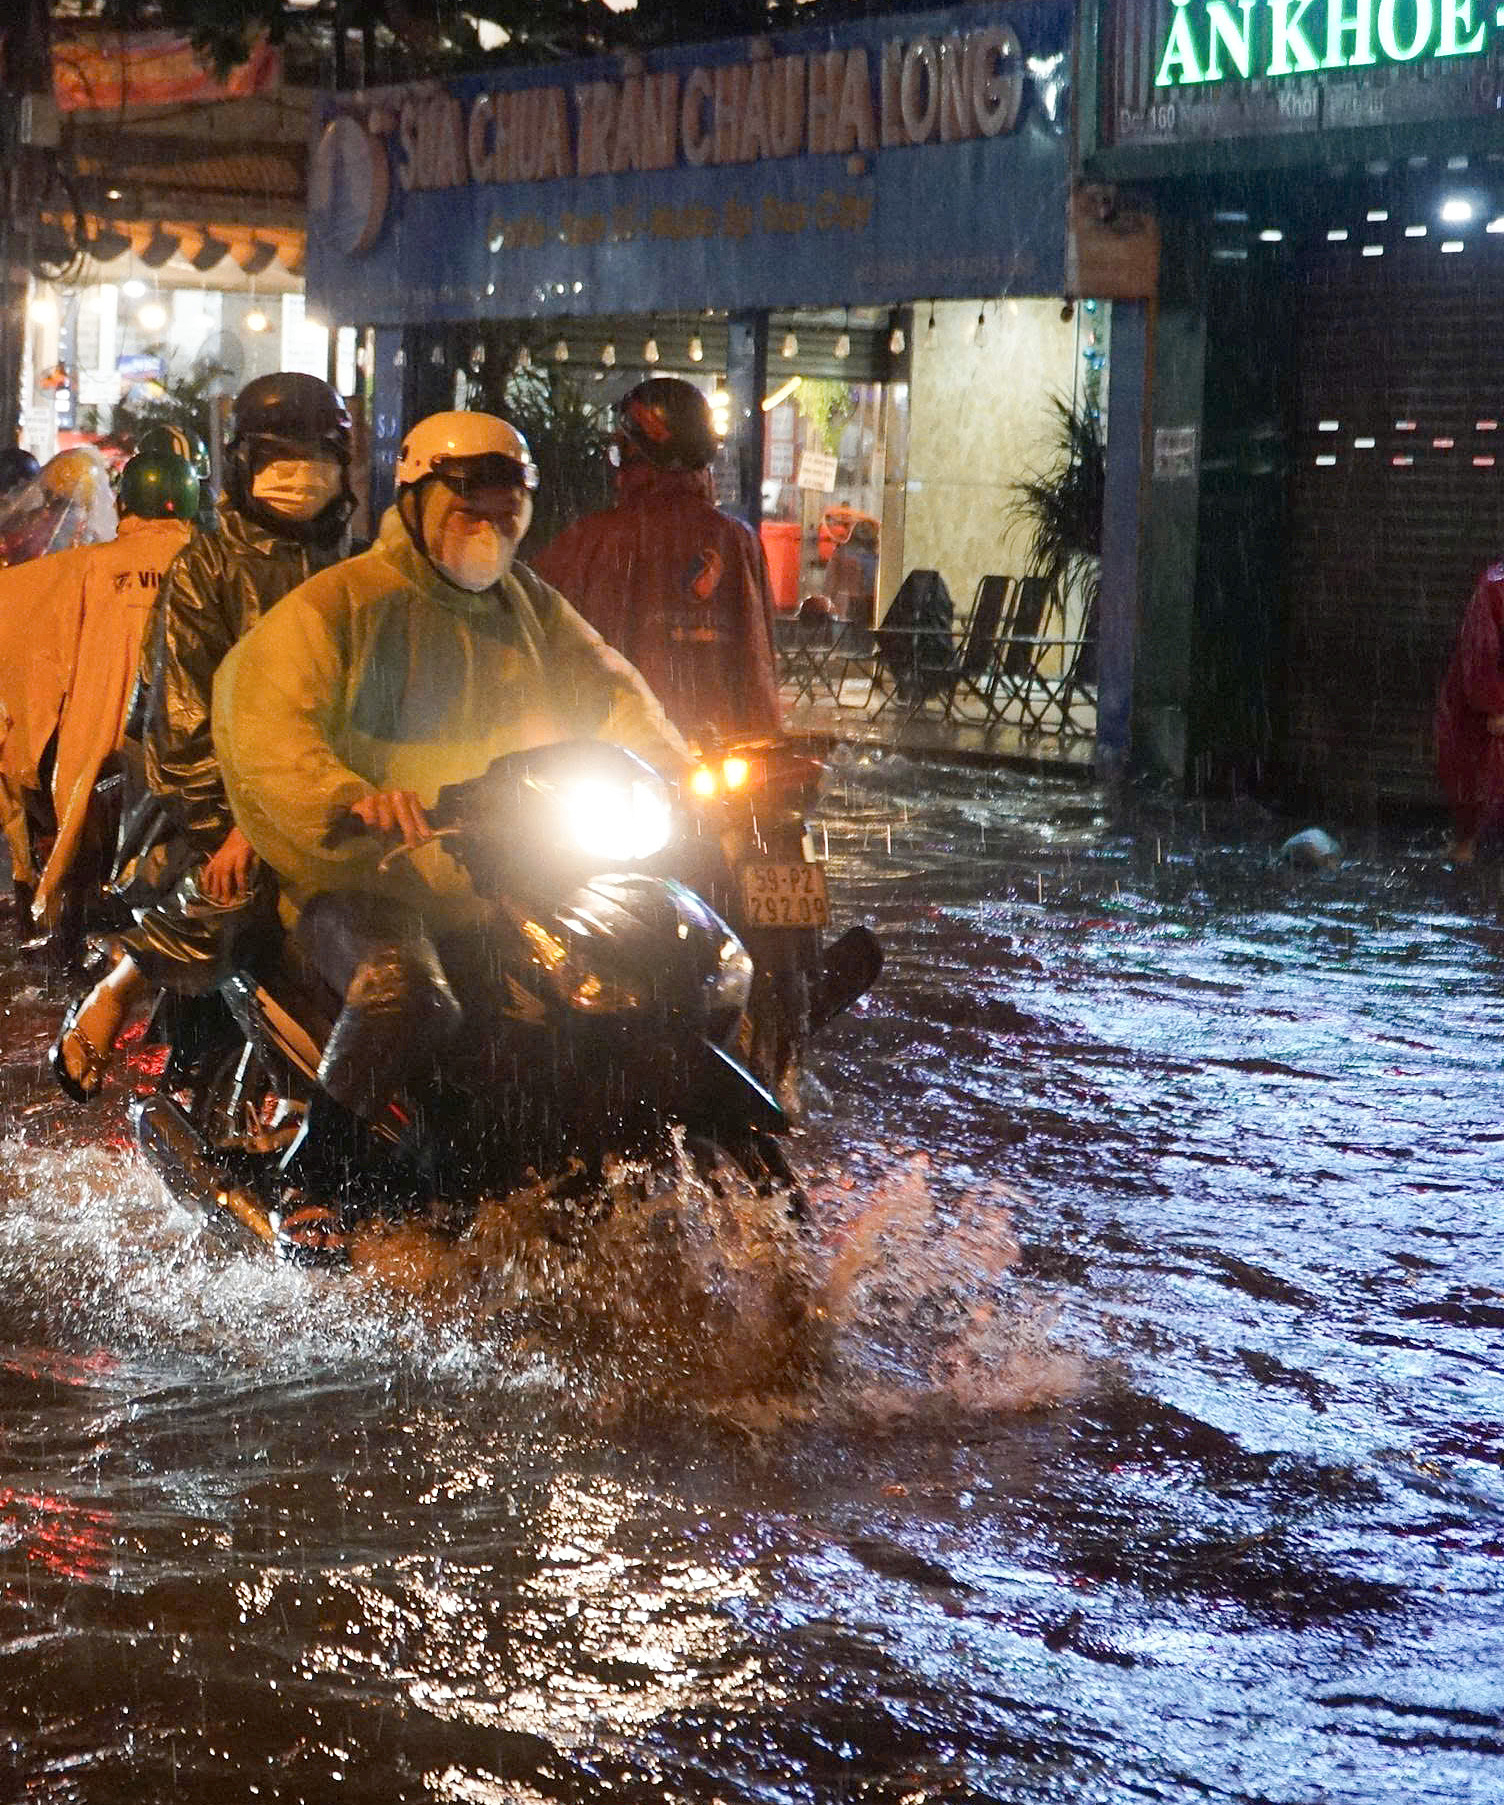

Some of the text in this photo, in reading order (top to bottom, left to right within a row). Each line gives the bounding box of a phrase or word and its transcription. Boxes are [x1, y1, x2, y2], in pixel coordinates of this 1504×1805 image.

[469, 86, 575, 183] CHUA
[880, 25, 1023, 147] LONG
[1151, 104, 1176, 129] 160
